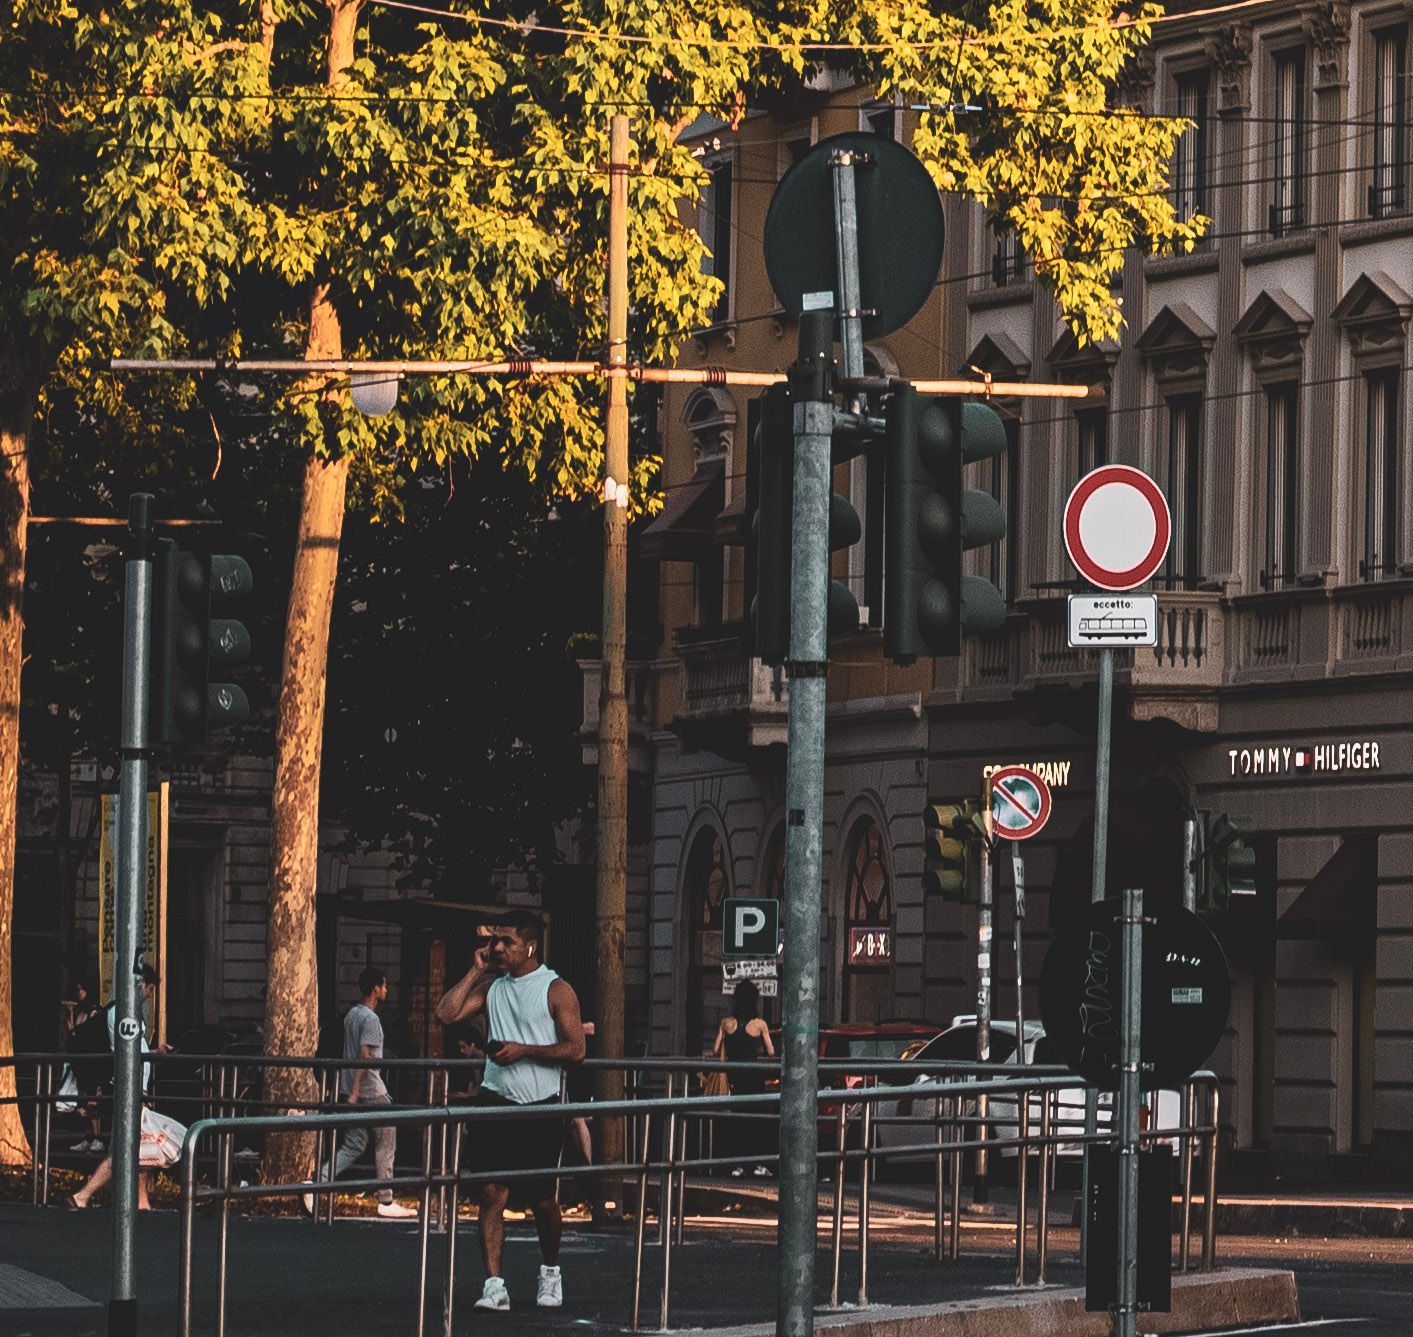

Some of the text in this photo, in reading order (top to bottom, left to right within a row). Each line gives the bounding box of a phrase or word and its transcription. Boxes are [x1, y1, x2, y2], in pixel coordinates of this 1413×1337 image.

[1228, 742, 1380, 774] TOMMY HILFIGER
[735, 906, 766, 948] P
